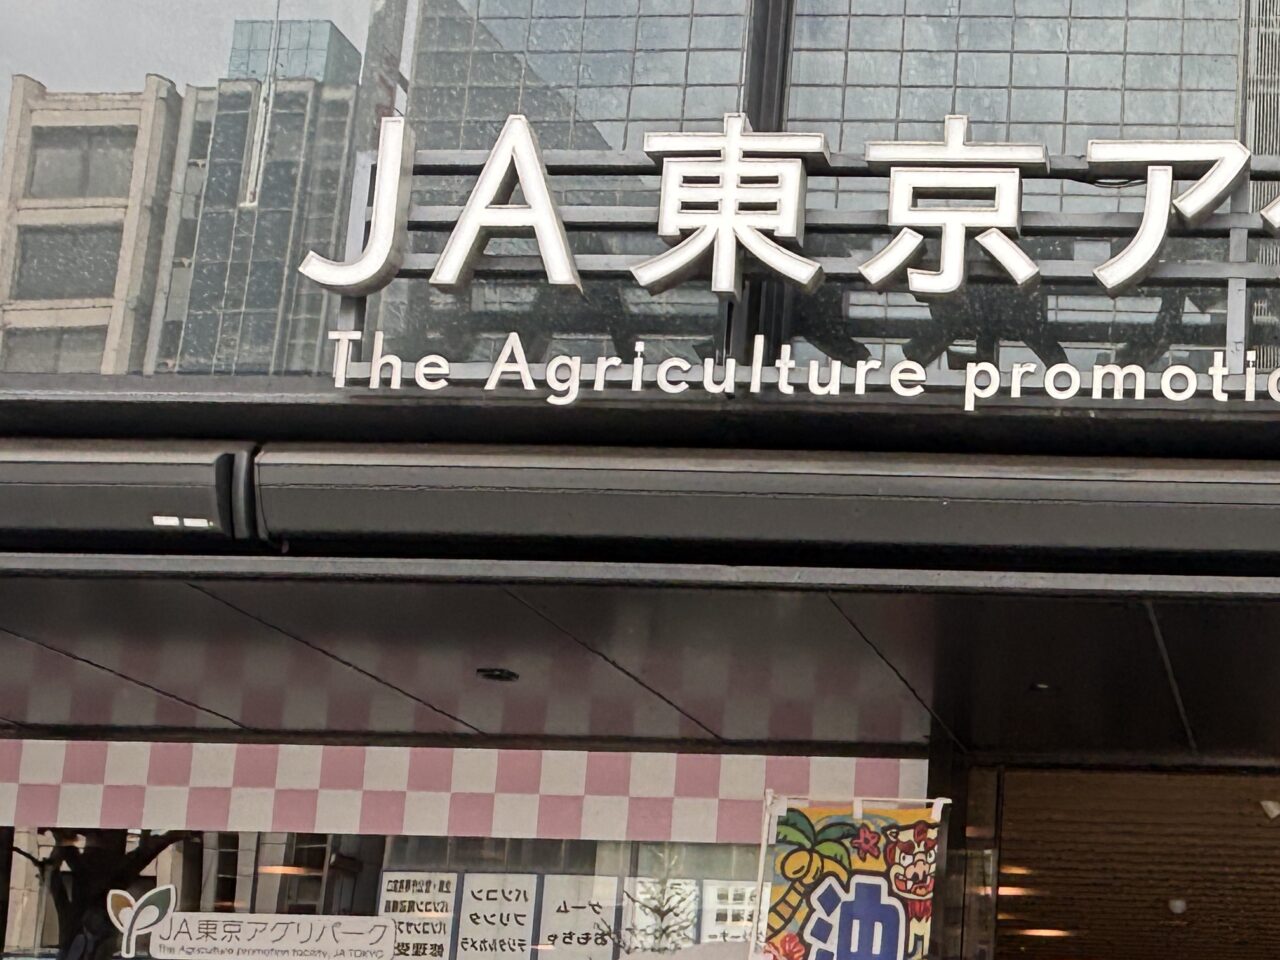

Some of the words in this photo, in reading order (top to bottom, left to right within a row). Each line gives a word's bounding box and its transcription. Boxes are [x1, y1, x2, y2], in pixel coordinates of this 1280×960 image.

[327, 330, 450, 391] The
[484, 331, 927, 406] Agriculture
[158, 918, 387, 946] JA東京アグリパーク
